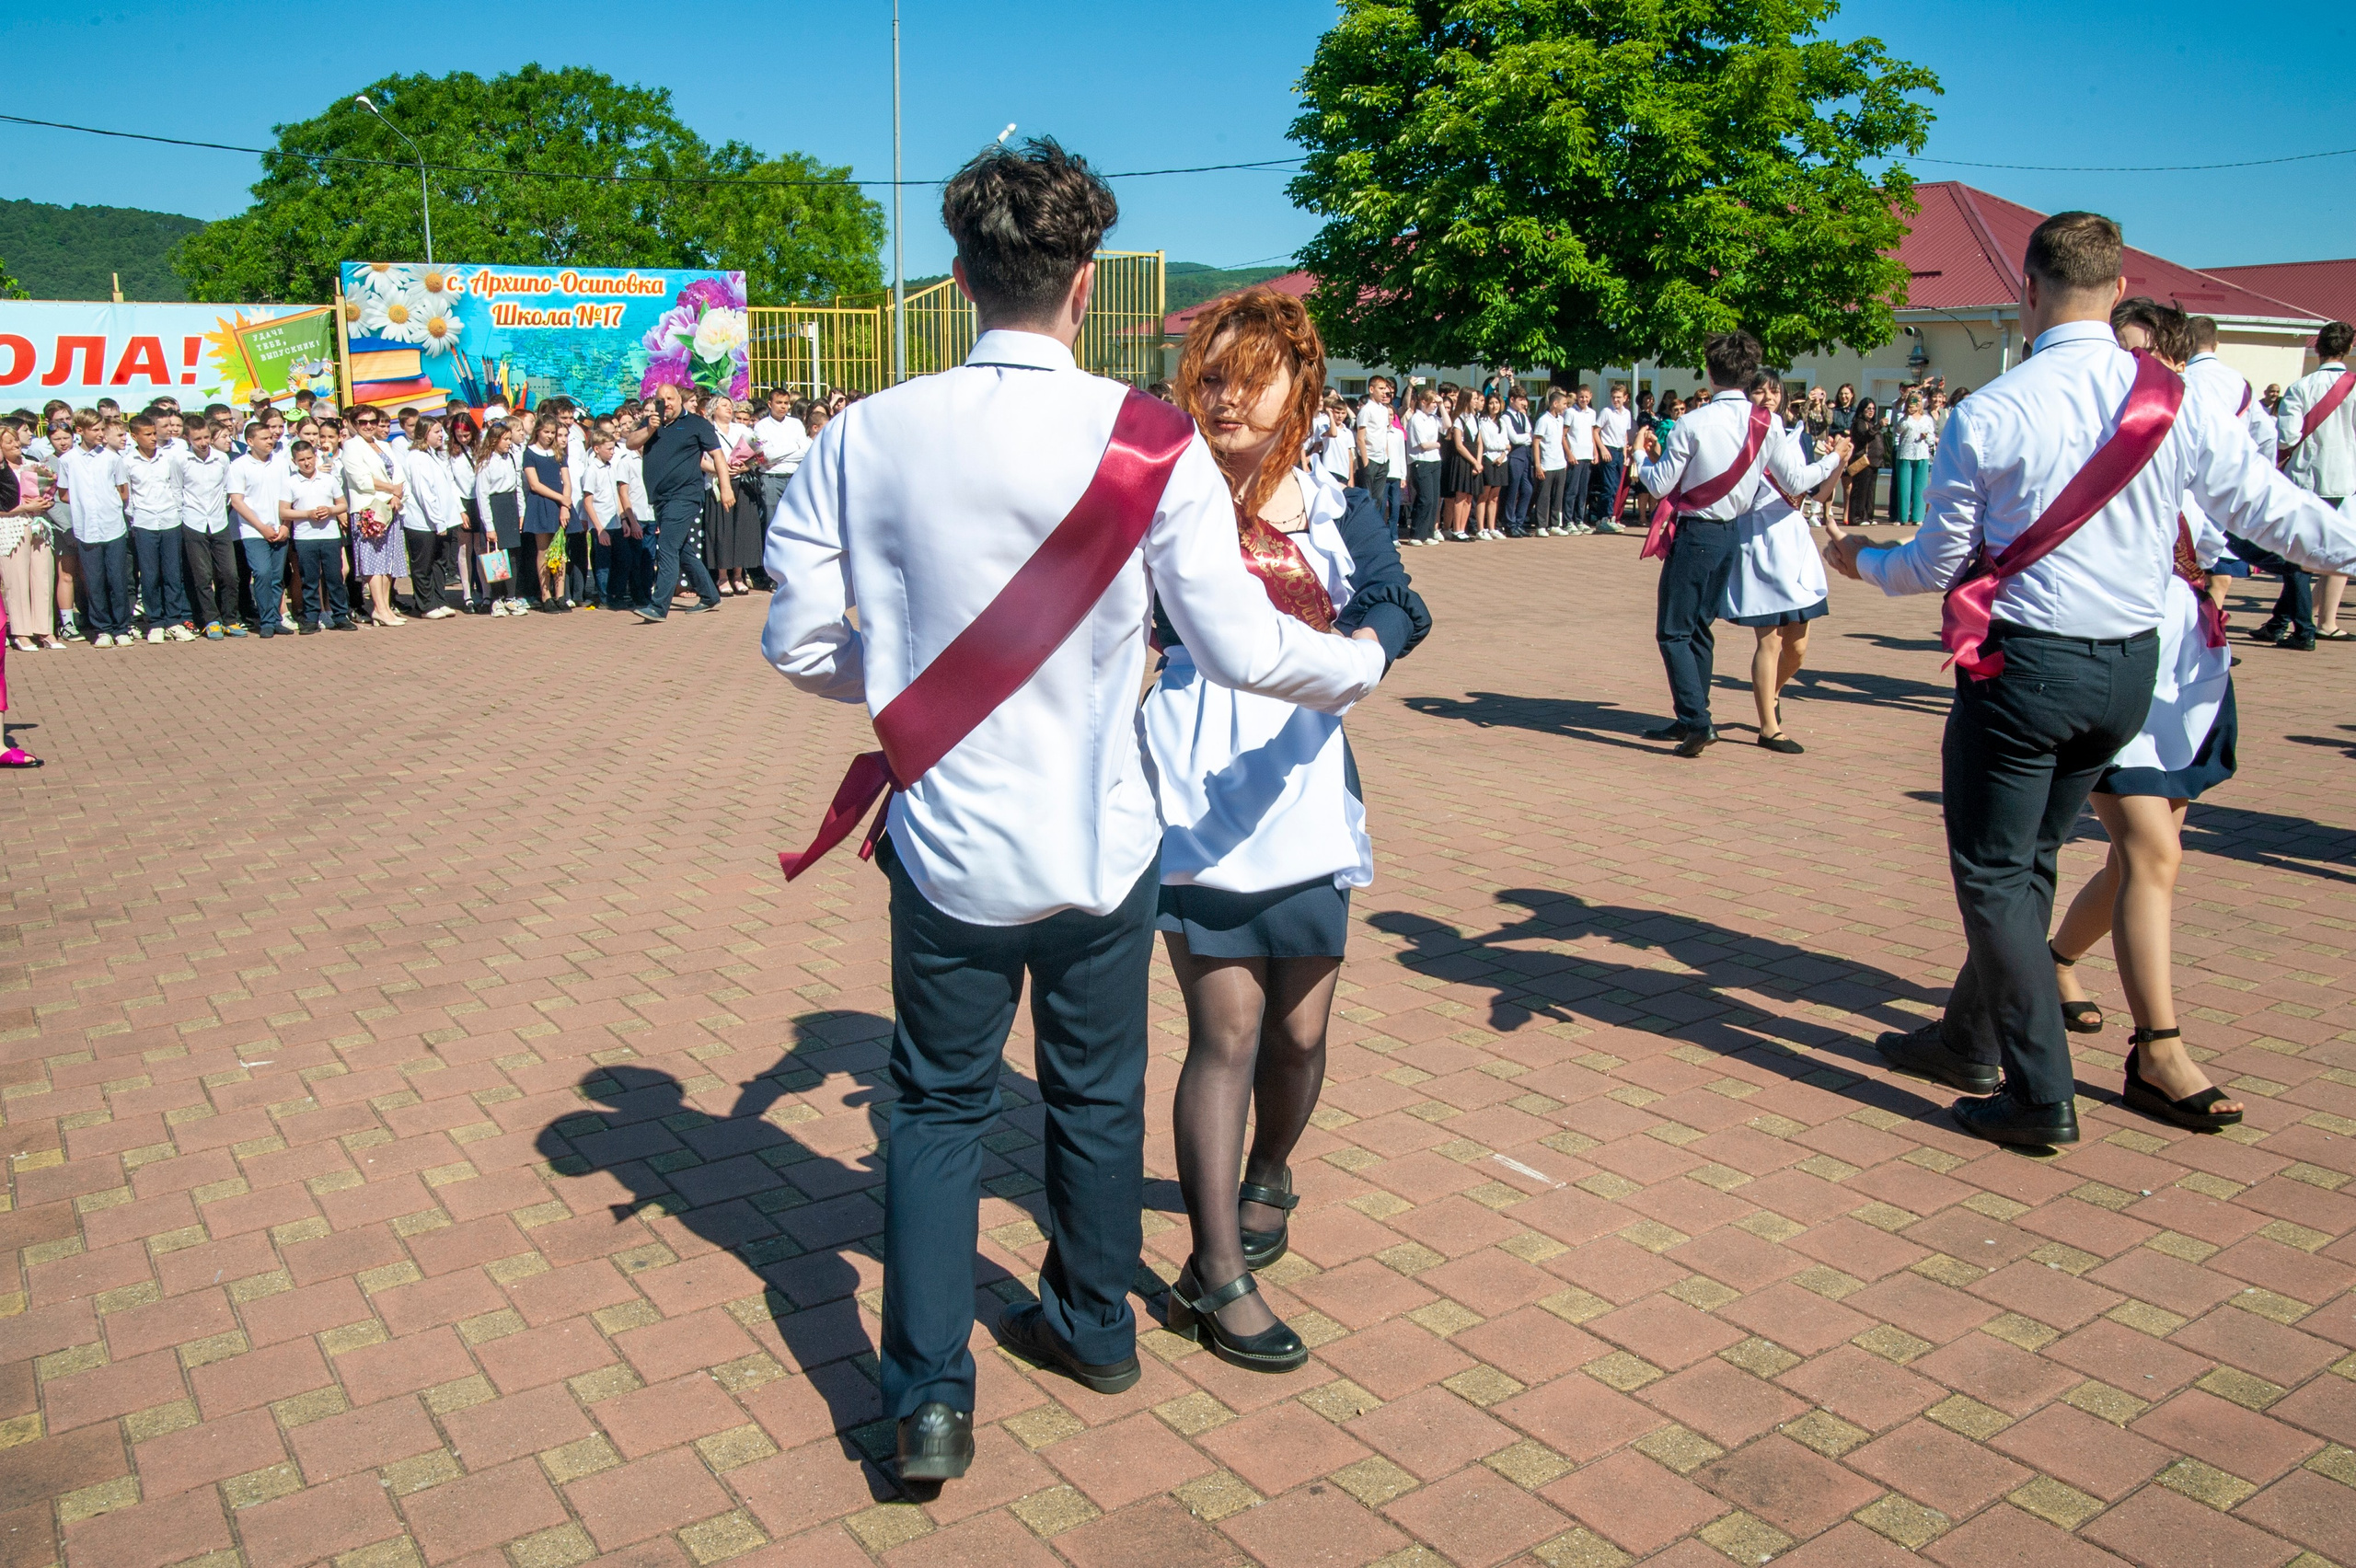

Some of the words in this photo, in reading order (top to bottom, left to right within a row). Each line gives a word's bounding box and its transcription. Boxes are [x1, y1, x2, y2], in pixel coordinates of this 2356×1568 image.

[446, 275, 463, 292] с.
[470, 271, 664, 298] Архипо-Осиповка
[492, 304, 571, 326] Школа
[575, 305, 624, 327] №17
[252, 328, 283, 341] УДАЧИ
[256, 339, 287, 352] ТЕБЕ,
[0, 334, 202, 386] ОЛА!
[260, 340, 320, 362] ВЫПУСКНИК!
